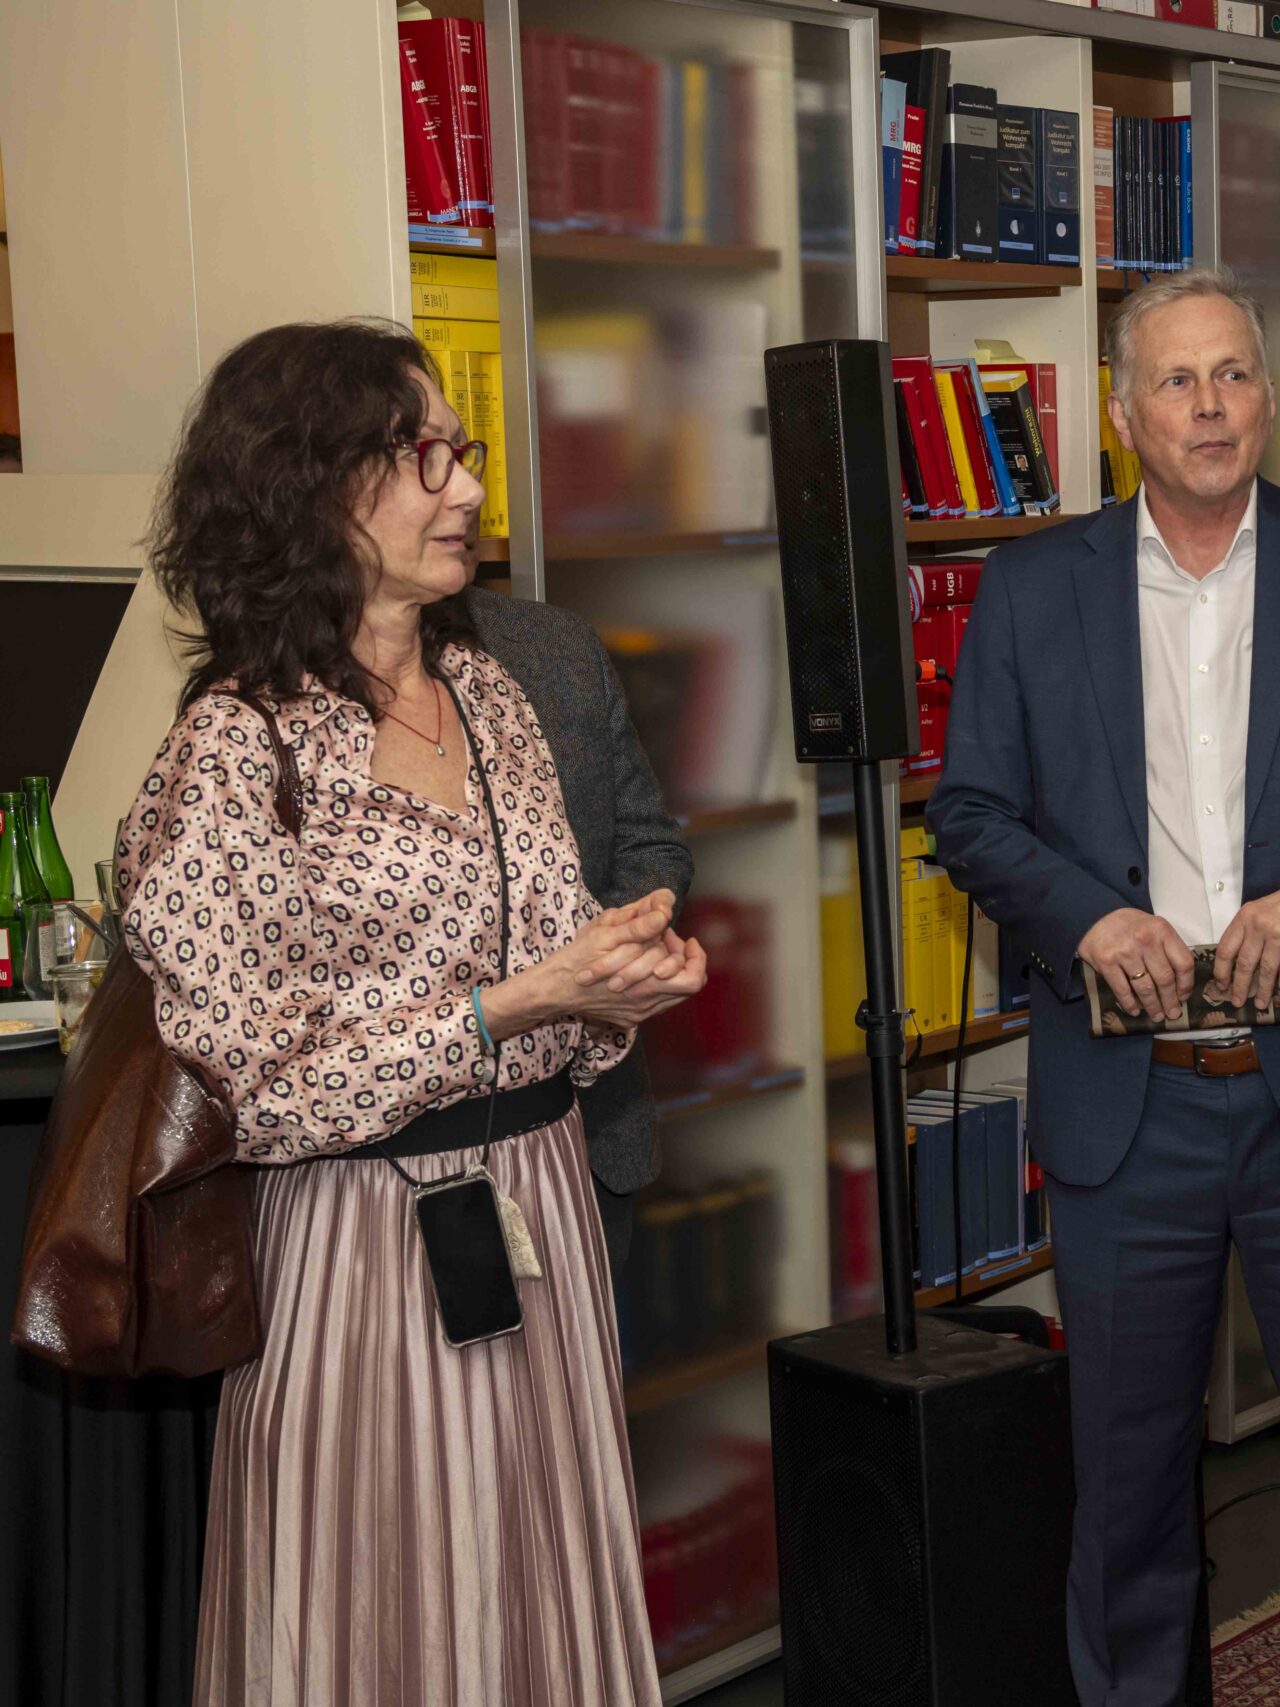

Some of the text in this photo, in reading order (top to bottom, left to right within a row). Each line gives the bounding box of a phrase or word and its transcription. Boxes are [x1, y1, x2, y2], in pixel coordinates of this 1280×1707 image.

[903, 140, 922, 155] MRG
[946, 572, 955, 597] UGB
[811, 717, 841, 728] VONYX
